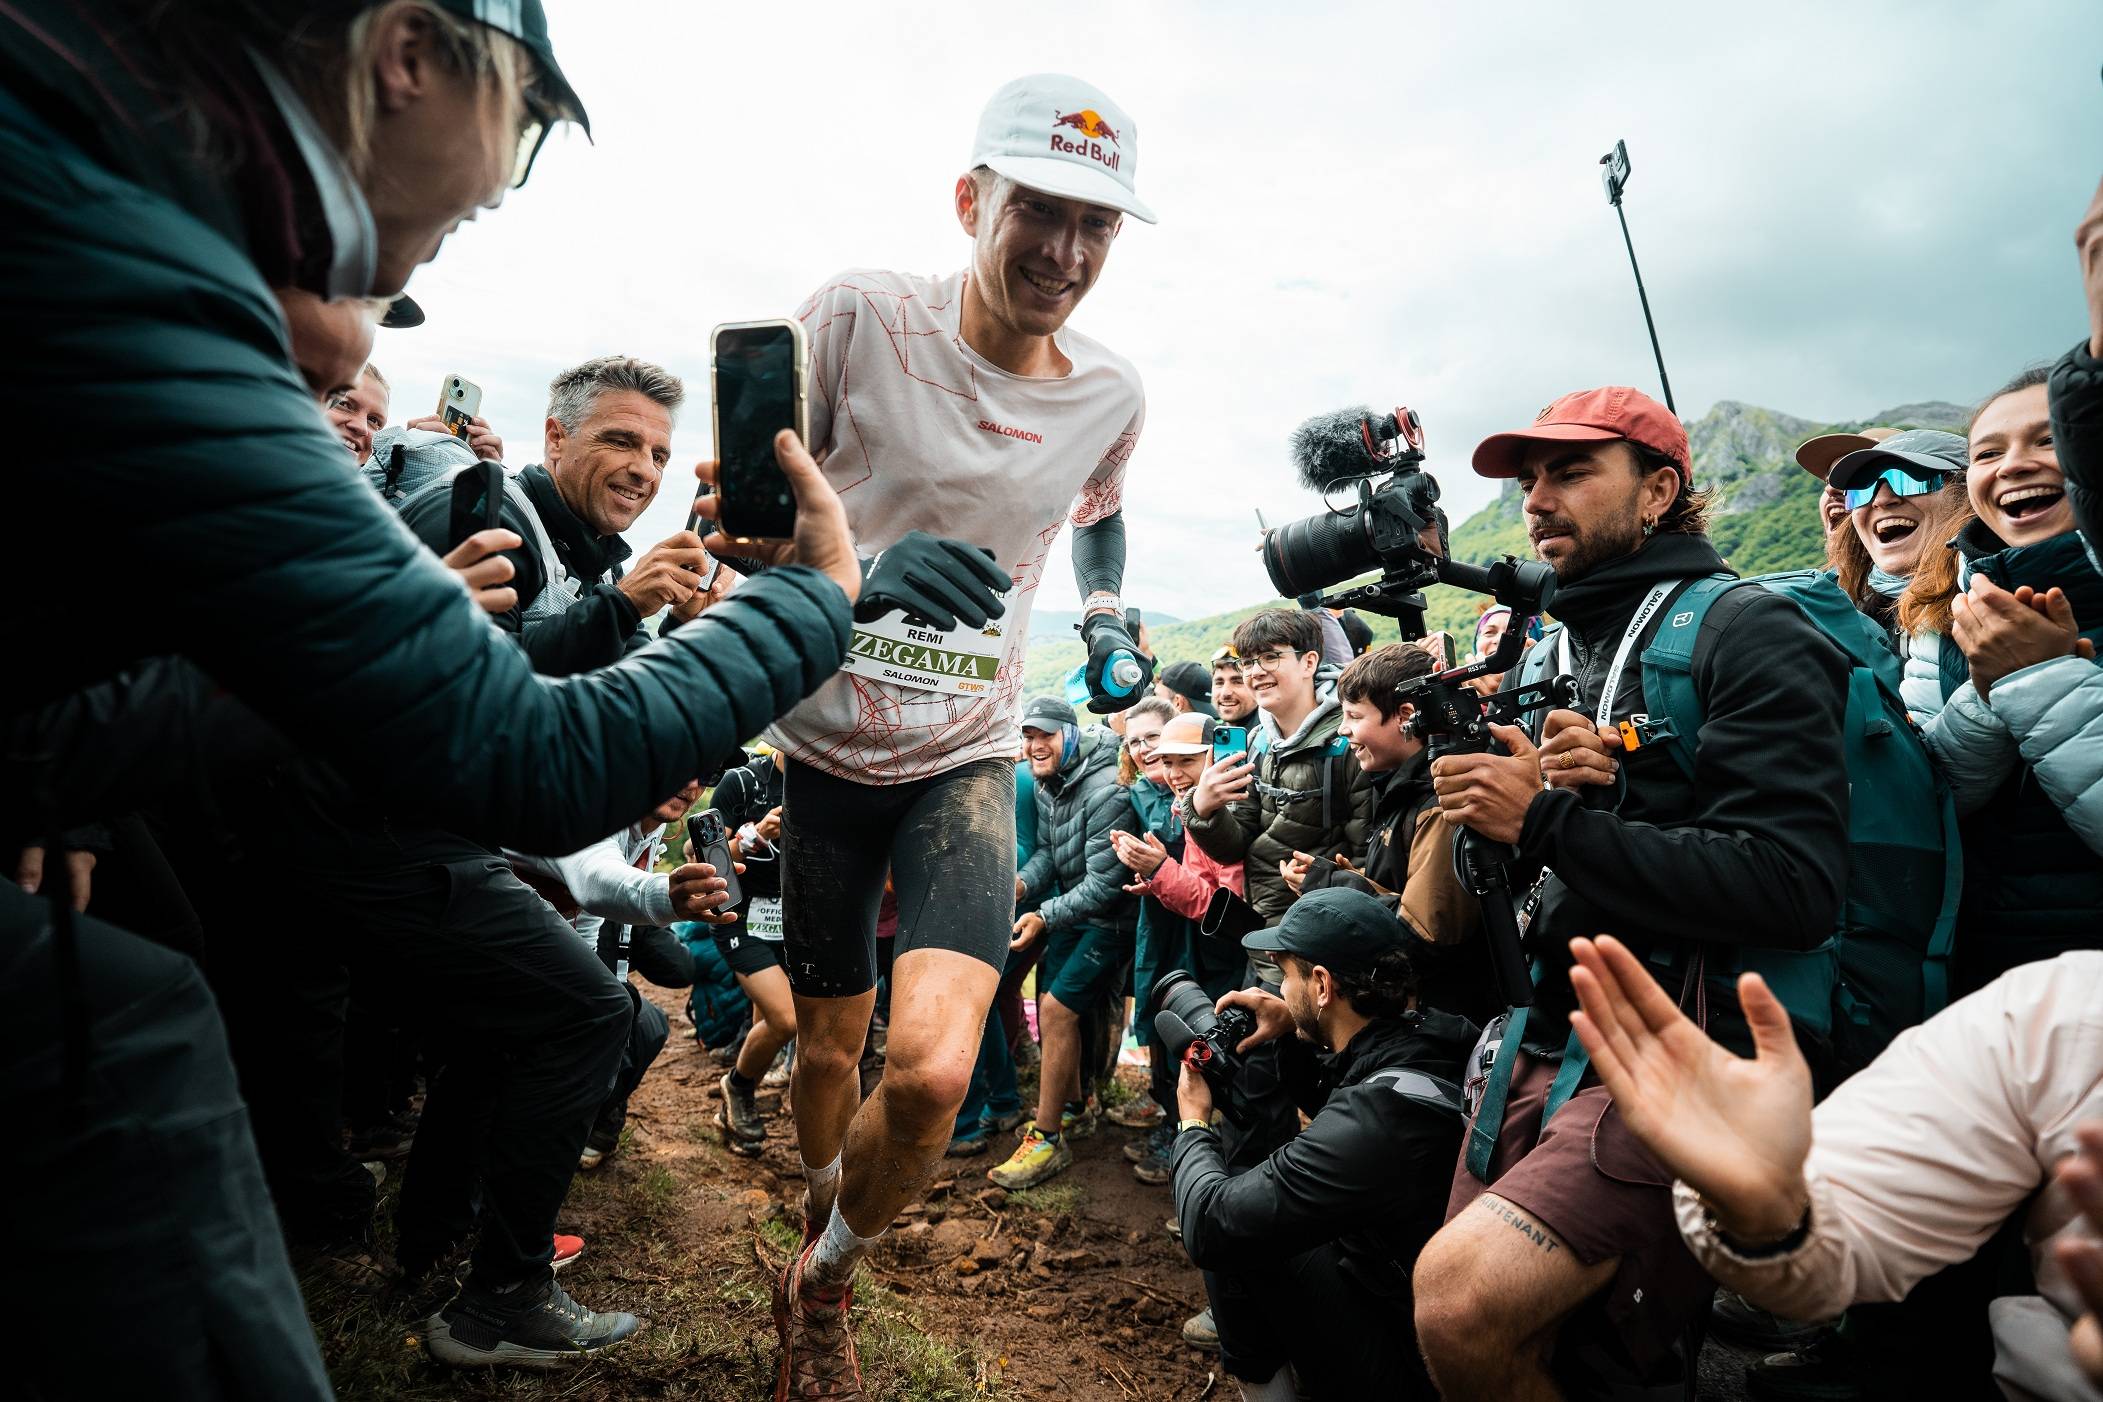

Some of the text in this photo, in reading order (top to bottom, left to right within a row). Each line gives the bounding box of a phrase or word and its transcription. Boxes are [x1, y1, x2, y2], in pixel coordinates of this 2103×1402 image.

[1050, 134, 1120, 172] Red Bull
[977, 420, 1043, 444] SALOMON
[1627, 589, 1664, 638] SALOMON
[906, 628, 944, 645] REMI
[850, 632, 980, 678] ZEGAMA
[882, 669, 940, 687] SALOMON
[957, 681, 985, 693] GTWS
[1600, 664, 1620, 721] SALOMON
